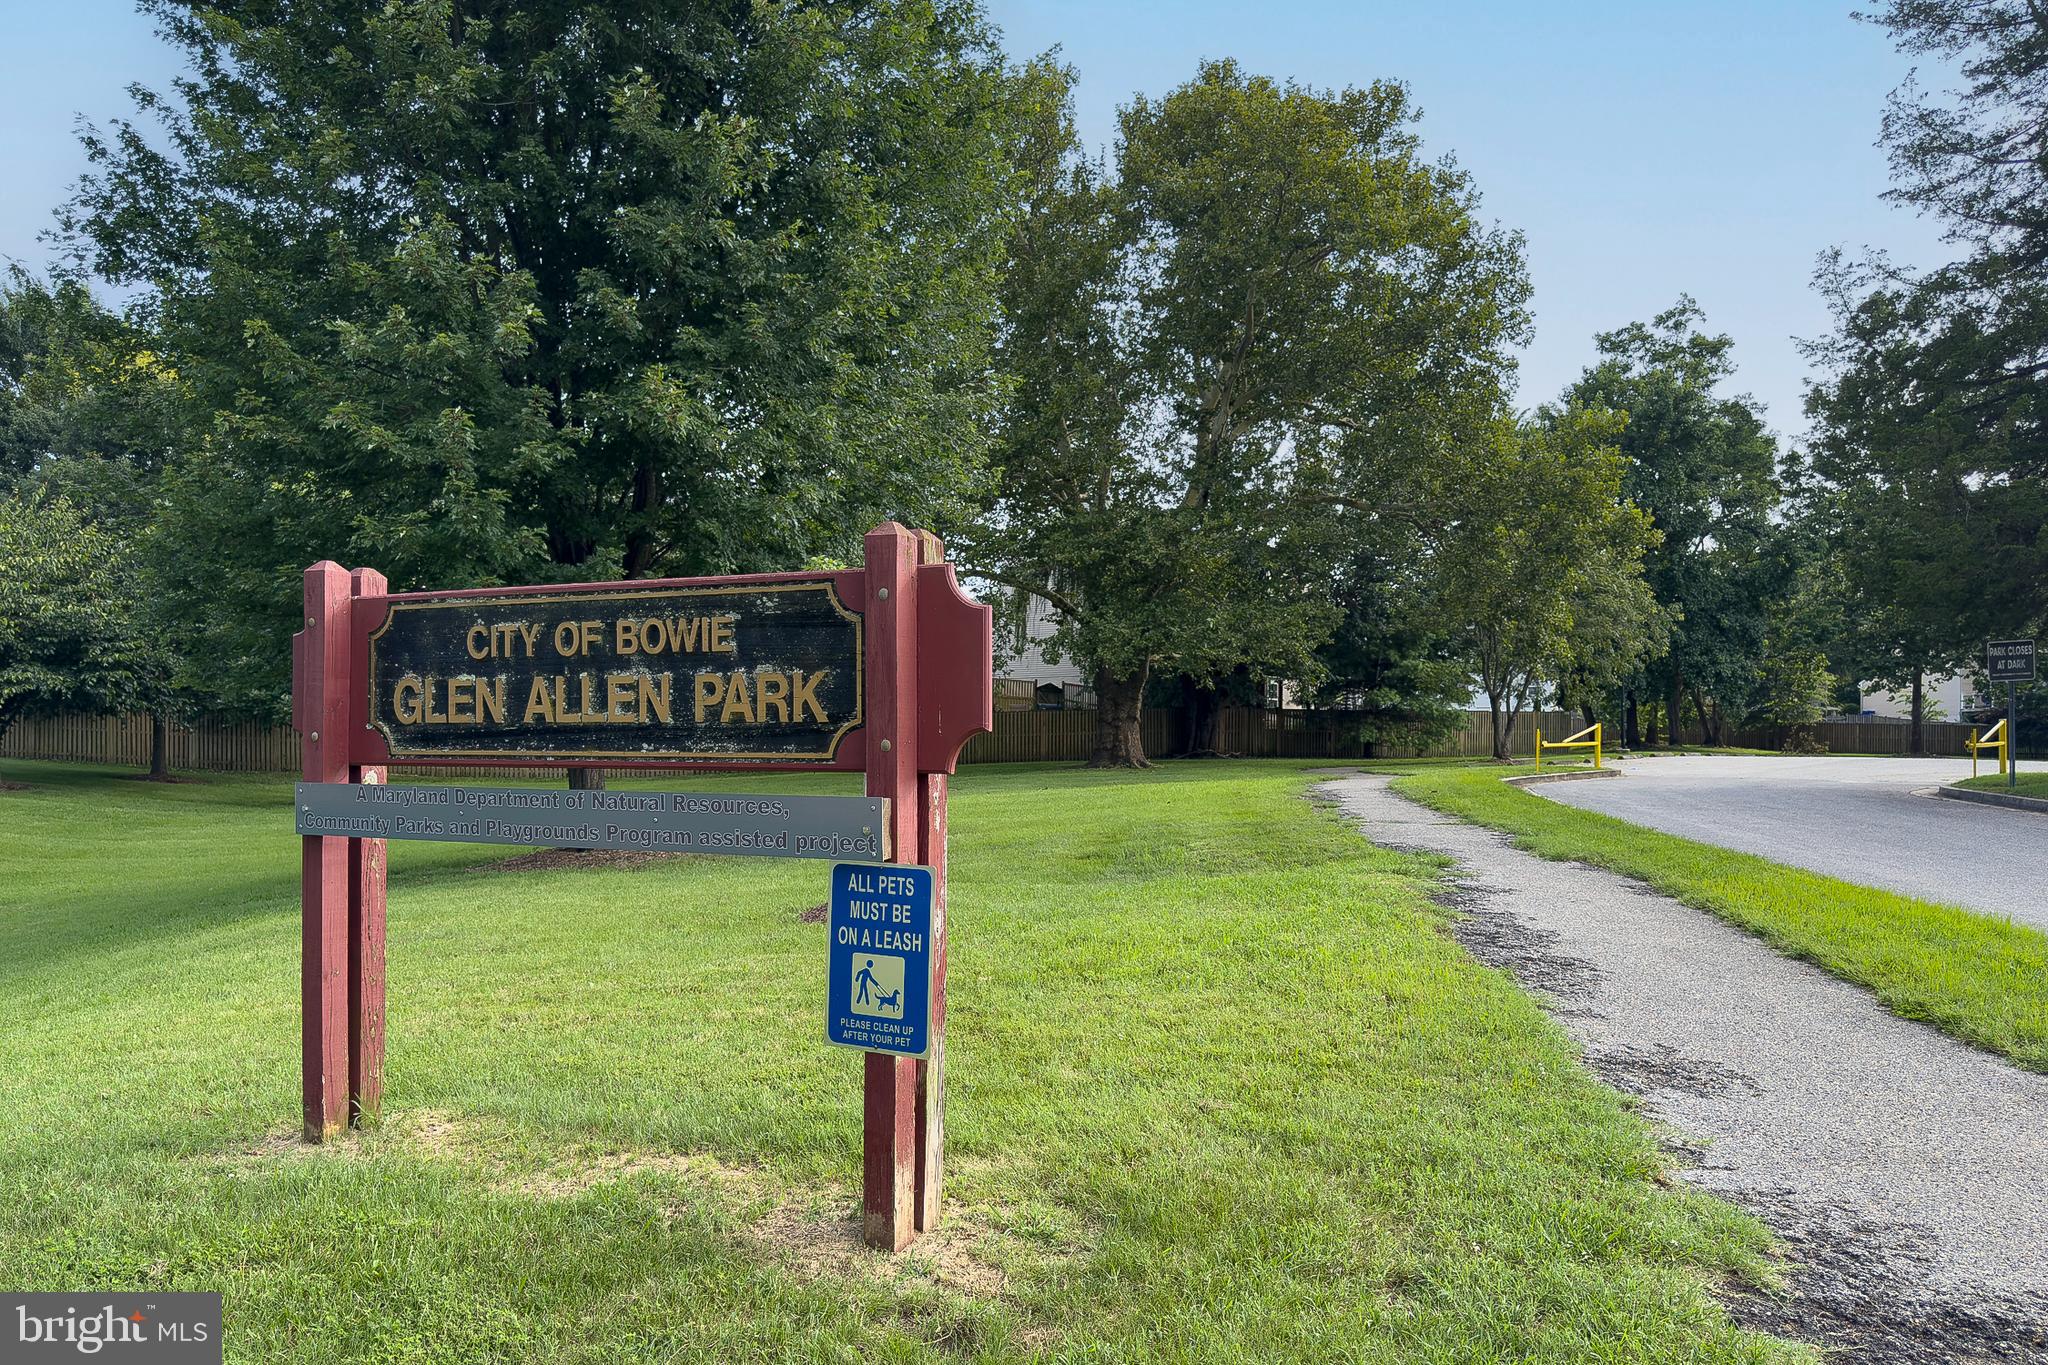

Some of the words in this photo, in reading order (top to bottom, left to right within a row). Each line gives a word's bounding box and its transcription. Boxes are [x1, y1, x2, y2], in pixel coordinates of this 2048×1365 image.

[467, 624, 539, 661] CITY
[554, 620, 602, 657] OF
[616, 615, 736, 655] BOWIE
[1989, 647, 2006, 656] PARK
[2007, 645, 2032, 656] CLOSES
[1997, 660, 2006, 670] AT
[2007, 659, 2026, 669] DARK
[393, 675, 505, 726] GLEN
[523, 672, 671, 723] ALLEN
[694, 670, 830, 724] PARK
[356, 785, 368, 802] A
[372, 786, 449, 807] Maryland
[454, 788, 560, 810] Department
[565, 792, 585, 809] of
[592, 792, 666, 812] Natural
[672, 794, 790, 820] Resources,
[304, 812, 390, 835] Community
[395, 816, 443, 834] Parks
[449, 817, 480, 836] and
[485, 819, 600, 844] Playgrounds
[605, 823, 693, 848] Program
[698, 829, 788, 850] assisted
[795, 832, 877, 856] project
[848, 873, 874, 893] ALL
[878, 875, 915, 897] PETS
[850, 900, 888, 921] MUST
[892, 904, 911, 924] BE
[838, 926, 857, 945] ON
[861, 928, 871, 947] A
[875, 930, 922, 952] LEASH
[840, 1017, 871, 1031] PLEASE
[873, 1022, 900, 1034] CLEAN
[902, 1024, 914, 1036] UP
[842, 1029, 868, 1042] AFTER
[870, 1033, 893, 1045] YOUR
[895, 1037, 911, 1048] PET
